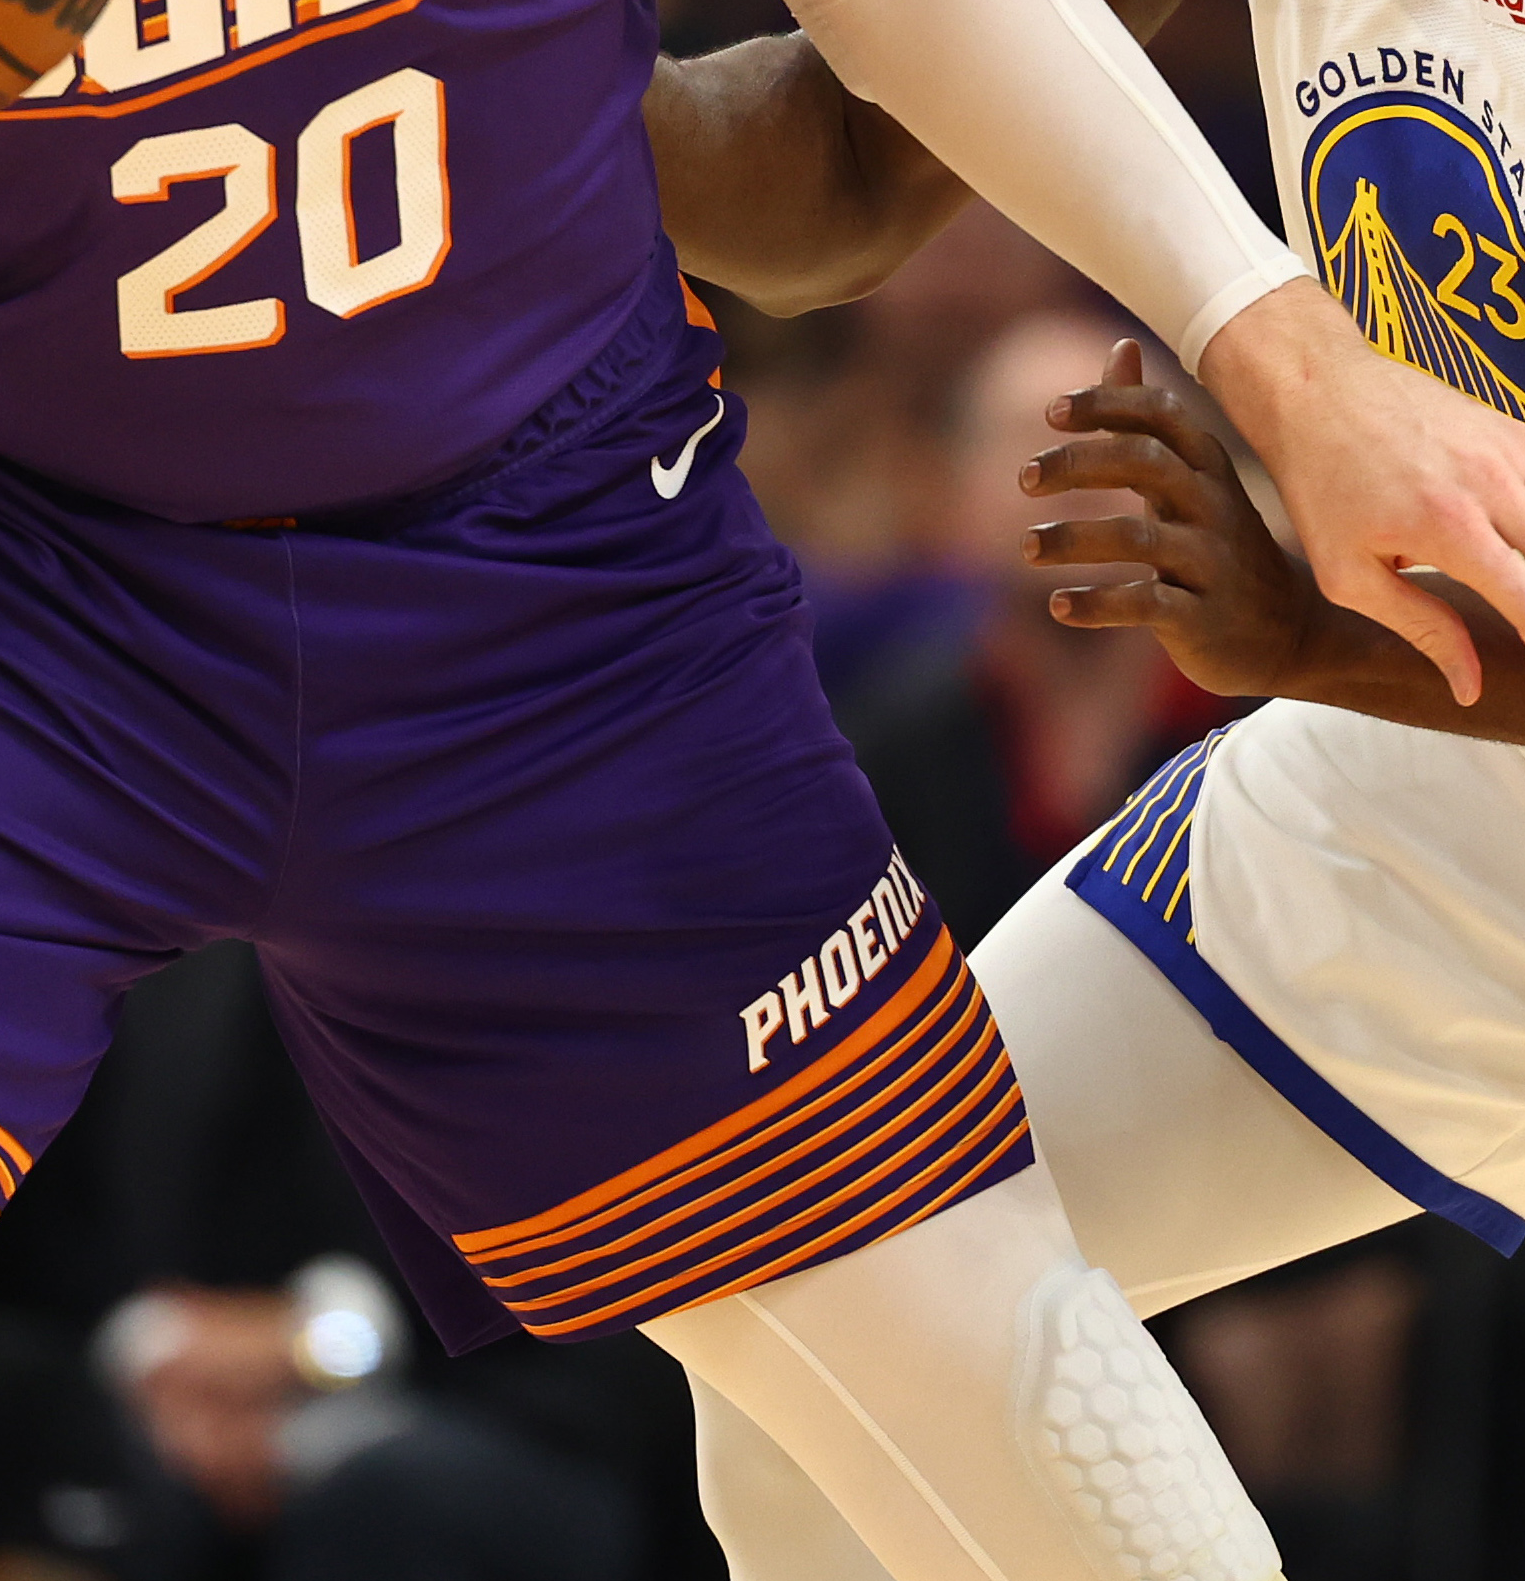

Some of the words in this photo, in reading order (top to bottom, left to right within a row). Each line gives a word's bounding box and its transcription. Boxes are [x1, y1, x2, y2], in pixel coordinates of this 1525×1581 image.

[1295, 47, 1465, 119] GOLDEN
[110, 67, 453, 360] 20
[738, 842, 926, 1074] PHOENIX
